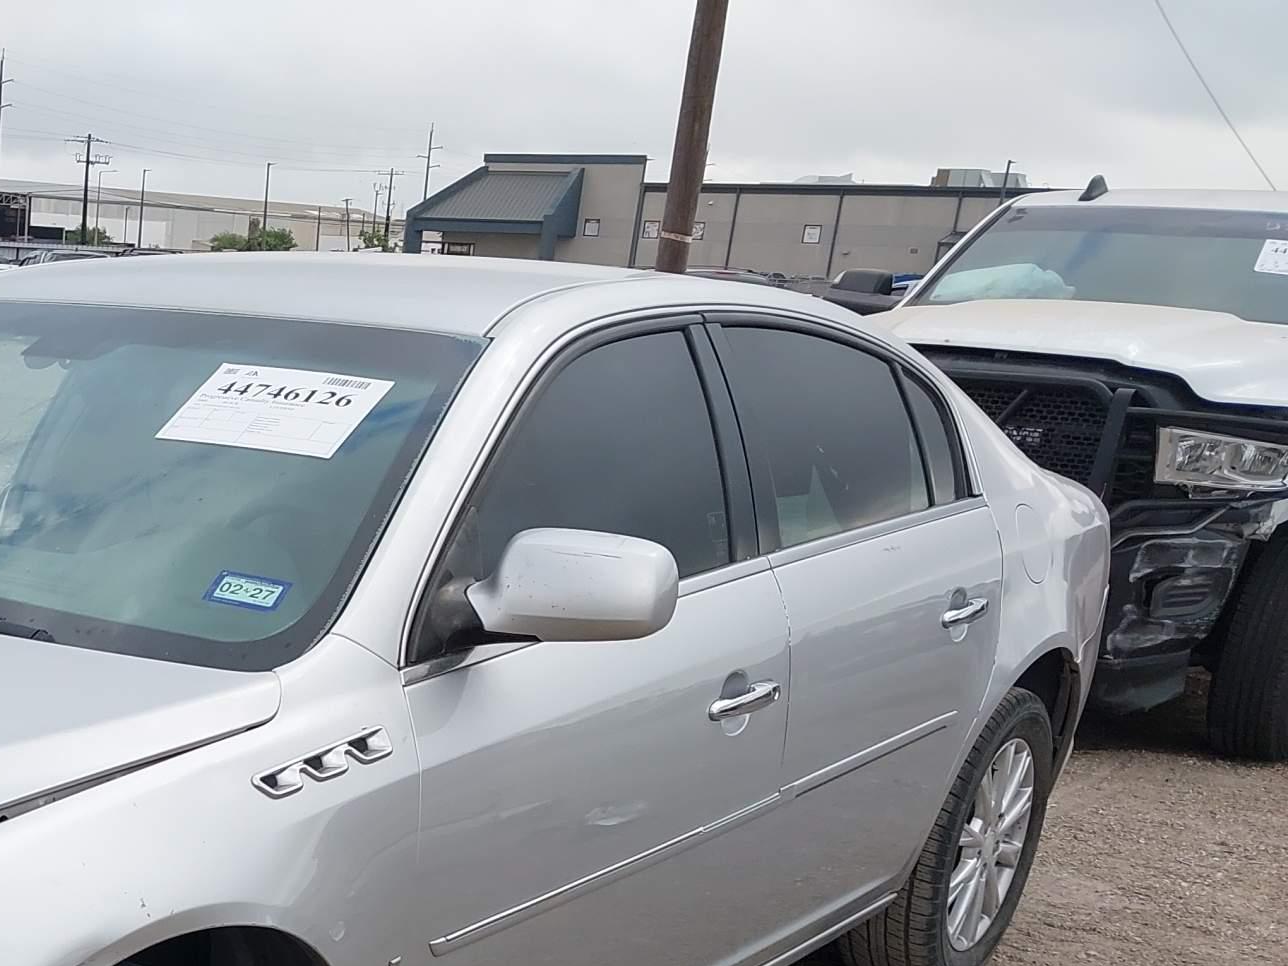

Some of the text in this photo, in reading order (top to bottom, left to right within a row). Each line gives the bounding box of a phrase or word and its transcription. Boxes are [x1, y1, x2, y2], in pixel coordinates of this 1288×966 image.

[217, 381, 357, 408] 44746126
[219, 581, 244, 595] 02
[248, 587, 276, 600] 27
